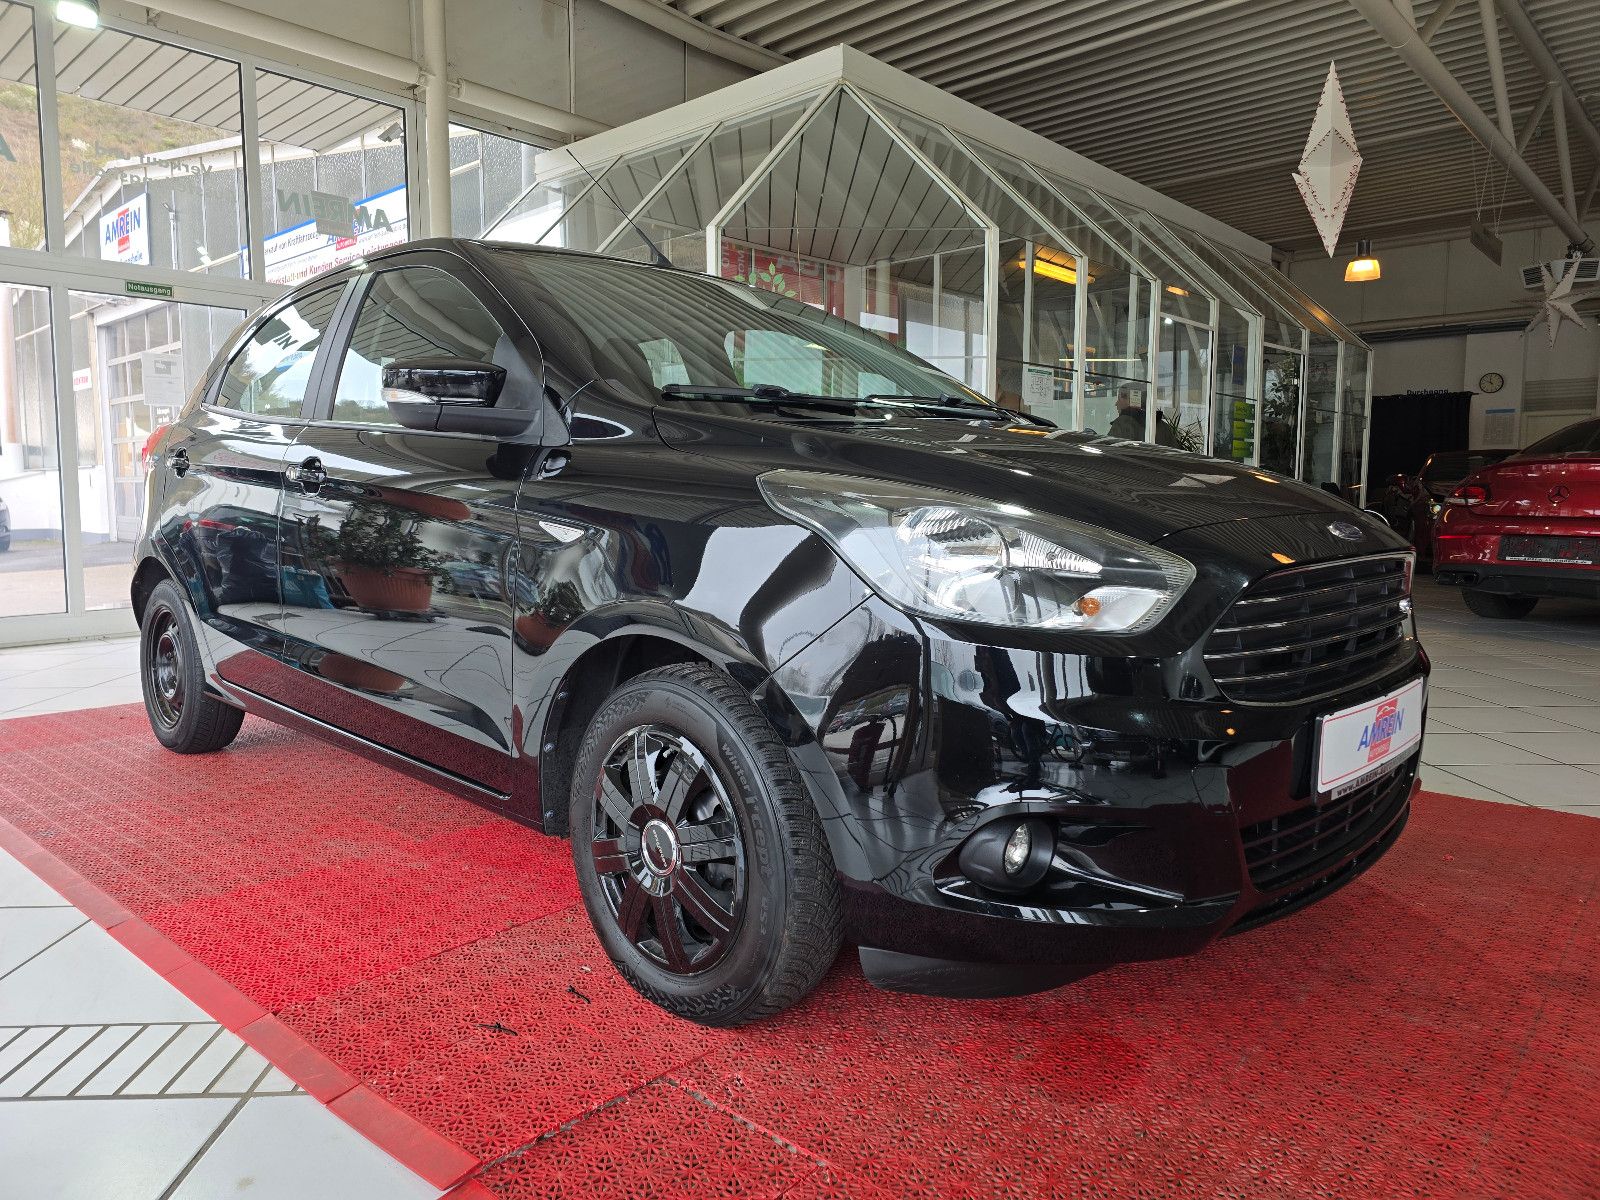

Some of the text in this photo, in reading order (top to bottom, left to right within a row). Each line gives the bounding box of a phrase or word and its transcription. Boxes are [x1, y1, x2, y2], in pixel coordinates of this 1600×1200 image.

[105, 207, 140, 245] AMREIN
[128, 283, 171, 296] Notausgang
[1357, 708, 1404, 751] AMREIN
